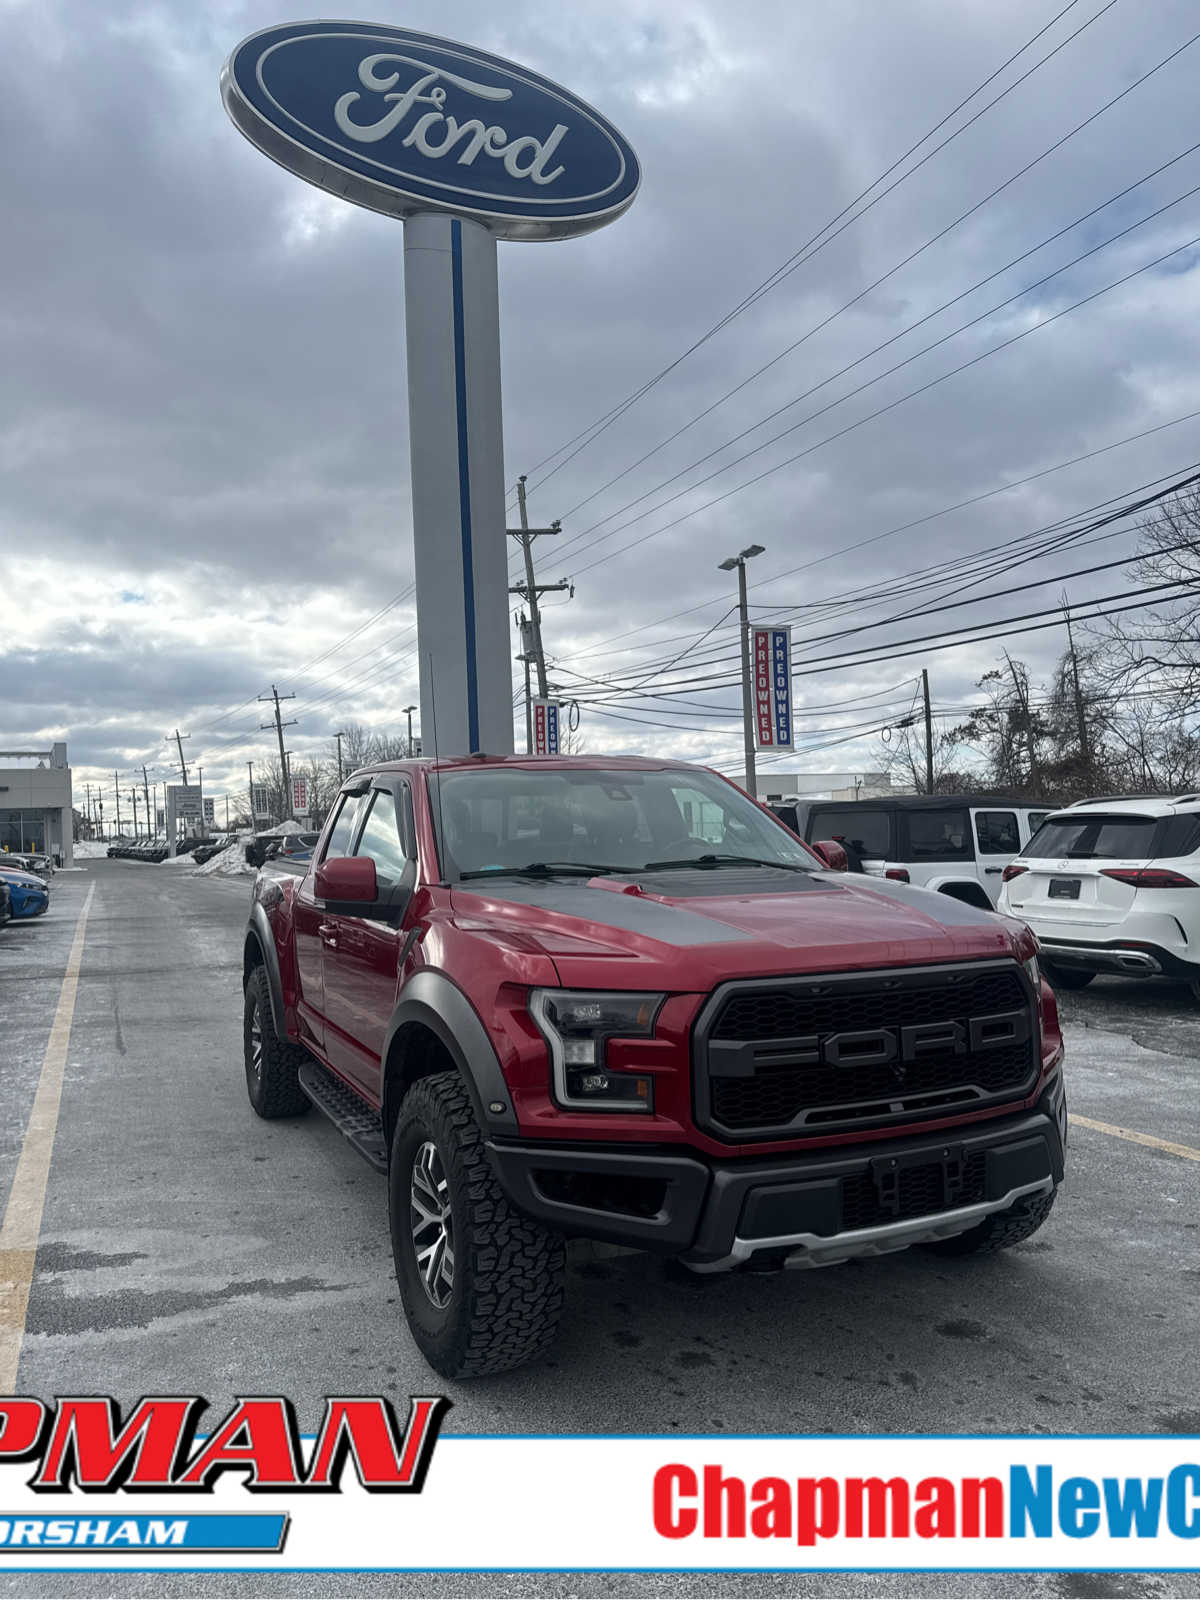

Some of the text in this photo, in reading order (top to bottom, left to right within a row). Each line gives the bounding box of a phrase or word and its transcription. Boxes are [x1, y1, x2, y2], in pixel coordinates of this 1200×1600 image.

[334, 53, 569, 185] Ford
[758, 636, 770, 741] PREOWNED
[776, 636, 788, 741] PREOWNED
[708, 1010, 1027, 1077] FORD
